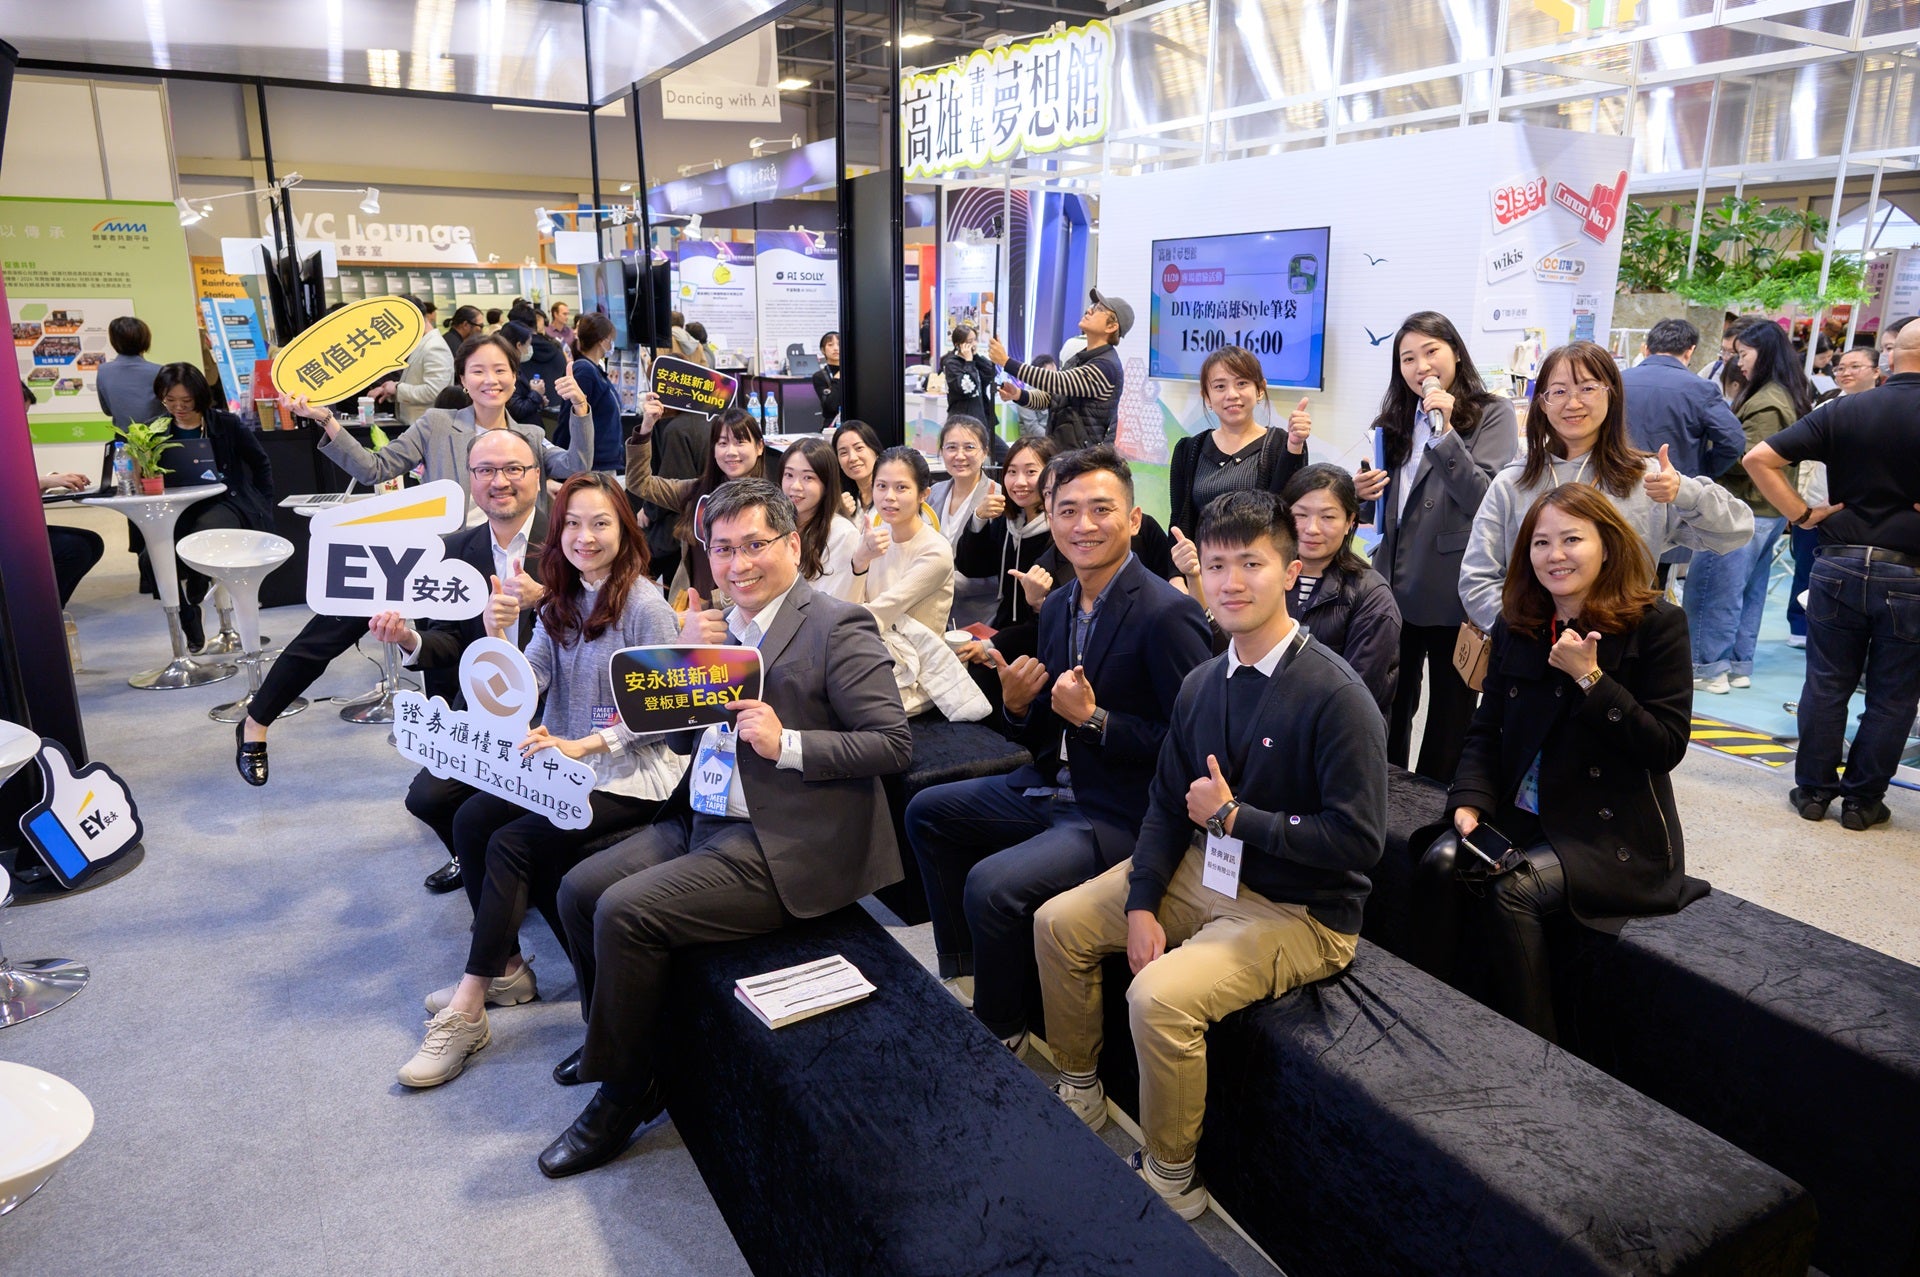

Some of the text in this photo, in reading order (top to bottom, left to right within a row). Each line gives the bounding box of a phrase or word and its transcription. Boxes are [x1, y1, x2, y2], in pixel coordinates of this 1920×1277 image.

[666, 90, 776, 109] Dancing with AI
[900, 35, 1102, 168] 高雄青年夢想館
[1494, 178, 1544, 216] Siser
[1588, 207, 1611, 231] No.1
[348, 214, 471, 250] Lounge
[1493, 248, 1523, 271] wikis
[202, 280, 248, 288] Rainforest
[787, 272, 824, 281] AI SOLLY
[1171, 299, 1297, 320] DIY你的高雄Style筆袋
[295, 308, 405, 391] 價值共創
[1181, 329, 1283, 355] 15:00-16:00
[656, 368, 716, 392] 安永挺新創
[624, 663, 729, 692] 安永挺新創
[401, 729, 582, 820] Taipei Exchange
[703, 770, 723, 785] VIP
